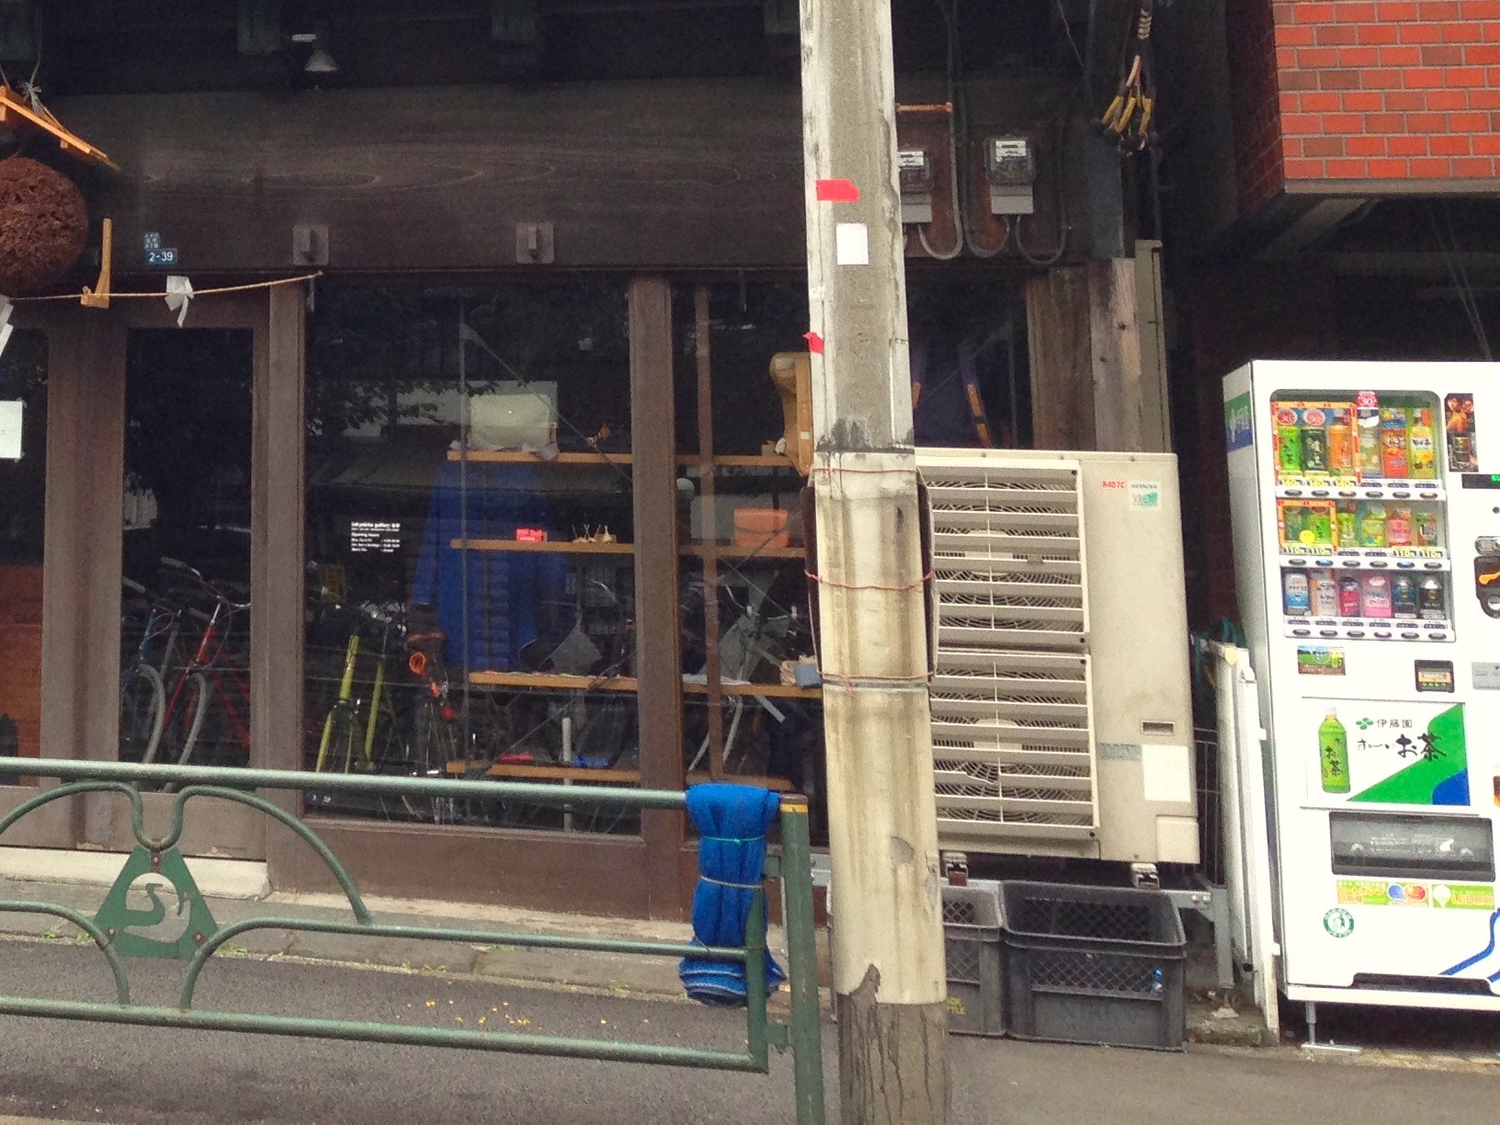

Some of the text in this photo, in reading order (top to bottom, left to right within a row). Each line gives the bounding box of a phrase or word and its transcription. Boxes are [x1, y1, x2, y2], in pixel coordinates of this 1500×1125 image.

[148, 251, 174, 262] 2-39
[1376, 719, 1413, 729] 伊藤園
